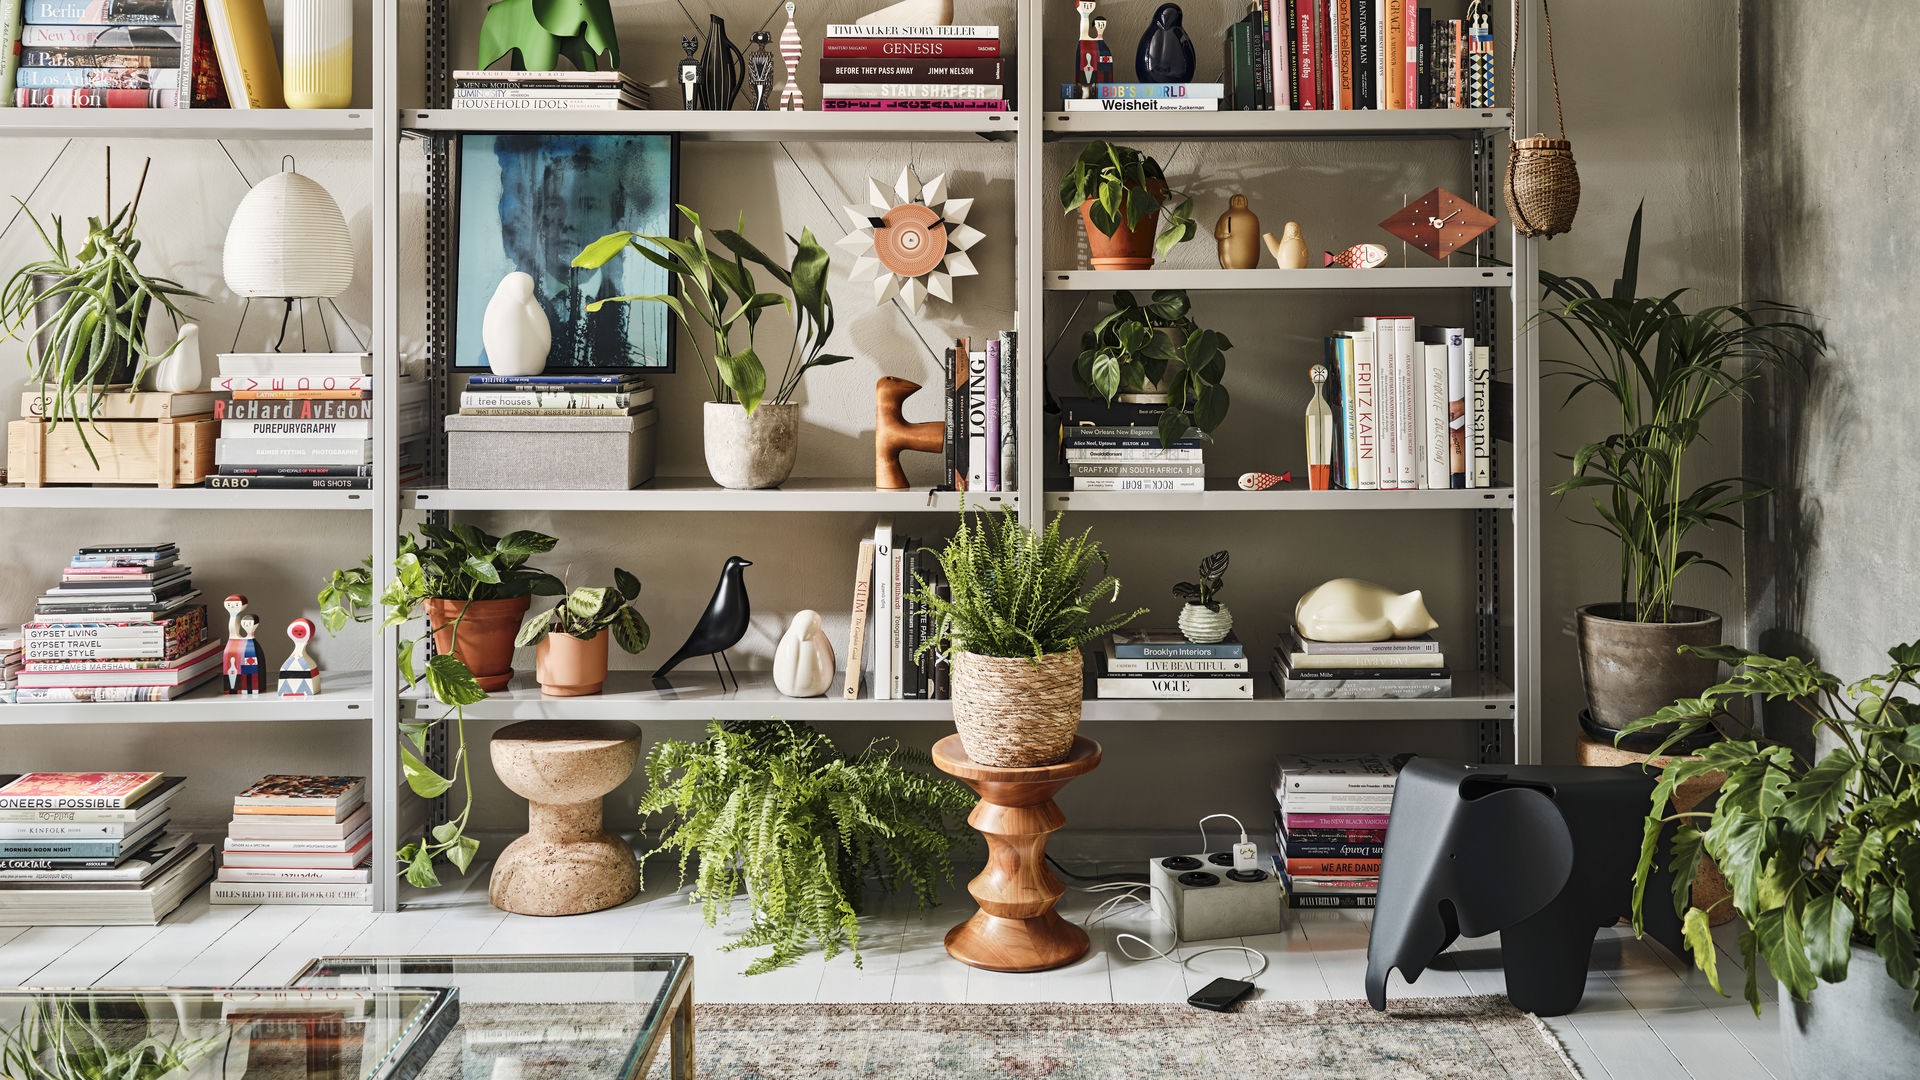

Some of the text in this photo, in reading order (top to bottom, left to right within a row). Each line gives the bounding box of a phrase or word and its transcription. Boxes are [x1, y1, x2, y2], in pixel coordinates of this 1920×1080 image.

[40, 3, 86, 18] Berlin
[1359, 0, 1367, 43] FANTASTIC
[1390, 0, 1401, 34] GRACE
[37, 28, 66, 42] New
[833, 26, 975, 36] TIM WALKER STORY TELLER
[183, 24, 192, 55] DAGMAR
[883, 43, 943, 55] GENESIS
[1360, 45, 1368, 64] MAN
[39, 51, 75, 67] Paris
[182, 56, 190, 72] VON
[835, 67, 914, 75] BEFORE THEY PASS AWAY
[928, 67, 974, 75] JIMMY NELSON
[1341, 50, 1351, 90] Basquiat
[32, 71, 60, 86] Los
[181, 73, 189, 96] TAUBE
[30, 89, 102, 106] London
[457, 89, 507, 98] LUMINOSITY
[881, 85, 985, 98] STAN SHAFFER
[1102, 85, 1136, 98] BOB'S
[456, 99, 569, 109] HOUSEHOLD IDOLS
[825, 100, 998, 109] HOTEL LACHAPELLE
[1102, 99, 1158, 111] Weisheit
[221, 377, 361, 391] AVEDON
[478, 397, 497, 406] tree
[499, 395, 532, 406] houses
[970, 359, 985, 438] LOVING
[214, 400, 293, 419] RicHard
[1357, 363, 1373, 459] FRITZ KAHN
[1474, 368, 1489, 458] Streisand
[253, 423, 337, 434] PUREPURYGRAPHY
[211, 478, 250, 488] GABO
[1121, 480, 1142, 490] BOAT
[1152, 480, 1174, 490] ROCK
[855, 581, 867, 613] KILIM
[68, 640, 102, 648] TRAVEL
[1143, 648, 1212, 656] Brooklyn Interiors
[1146, 662, 1226, 670] LIVE BEAUTIFUL
[1152, 680, 1190, 692] VOGUE
[58, 799, 121, 808] POSSIBLE
[1340, 845, 1369, 855] Dandy
[1321, 863, 1381, 872] WE ARE DAND
[285, 891, 301, 899] BIG
